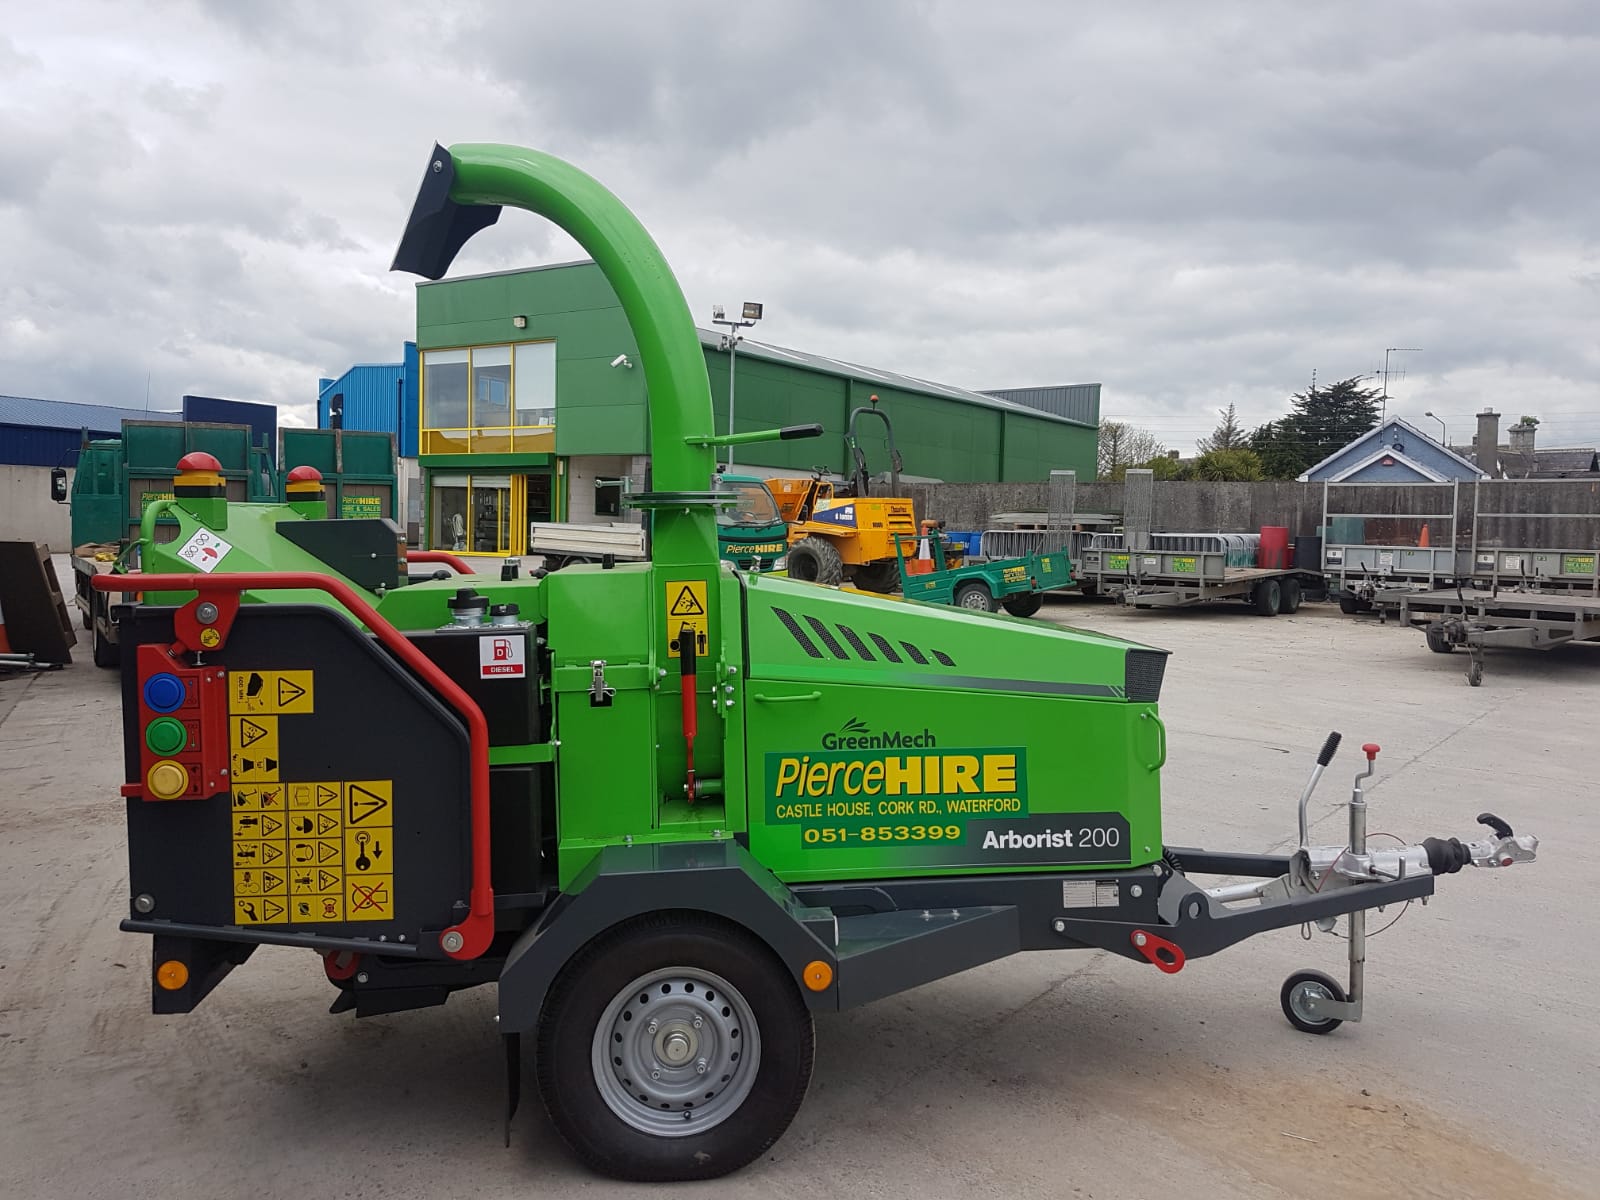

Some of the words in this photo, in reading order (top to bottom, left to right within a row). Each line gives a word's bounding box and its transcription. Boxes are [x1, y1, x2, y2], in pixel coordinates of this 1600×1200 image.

[726, 544, 783, 554] PierceHIRE
[497, 649, 504, 657] D
[822, 729, 936, 750] GreenMech
[775, 754, 1017, 797] PierceHIRE
[776, 803, 822, 819] CASTLE
[827, 802, 874, 817] HOUSE,
[878, 801, 915, 816] CORK
[919, 800, 942, 815] RD.,
[947, 798, 1021, 814] WATERFORD
[804, 825, 961, 843] 051-853399
[982, 829, 1073, 849] Arborist
[1078, 827, 1120, 848] 200
